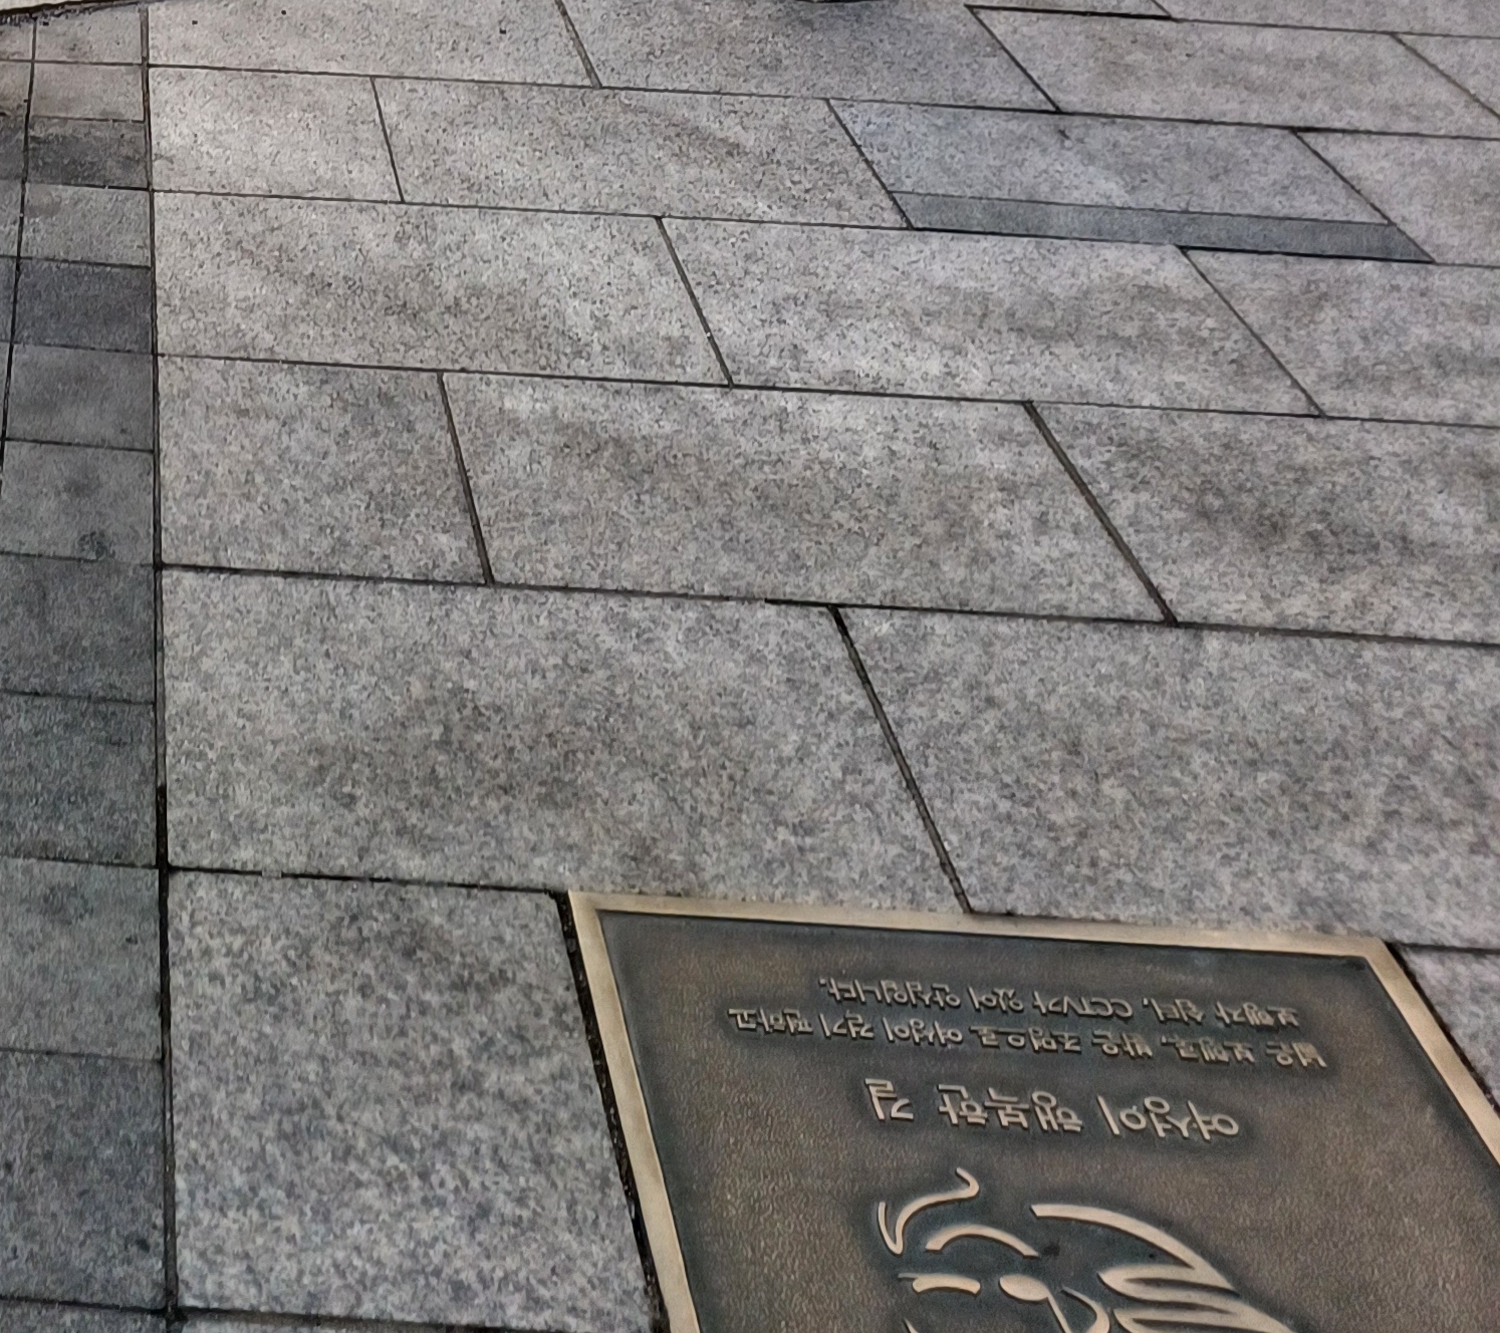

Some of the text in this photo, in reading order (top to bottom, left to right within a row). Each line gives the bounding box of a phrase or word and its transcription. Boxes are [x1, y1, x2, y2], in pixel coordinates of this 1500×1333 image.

[967, 985, 1025, 1014] 있어
[1031, 989, 1134, 1021] CCTV가
[1215, 999, 1300, 1029] 보행자
[727, 1007, 814, 1035] 편하고
[885, 1016, 964, 1047] 여성이
[969, 1024, 1083, 1053] 조명으로
[1091, 1030, 1154, 1059] 밝은
[864, 1077, 1240, 1142] 여성이 행복한 길
